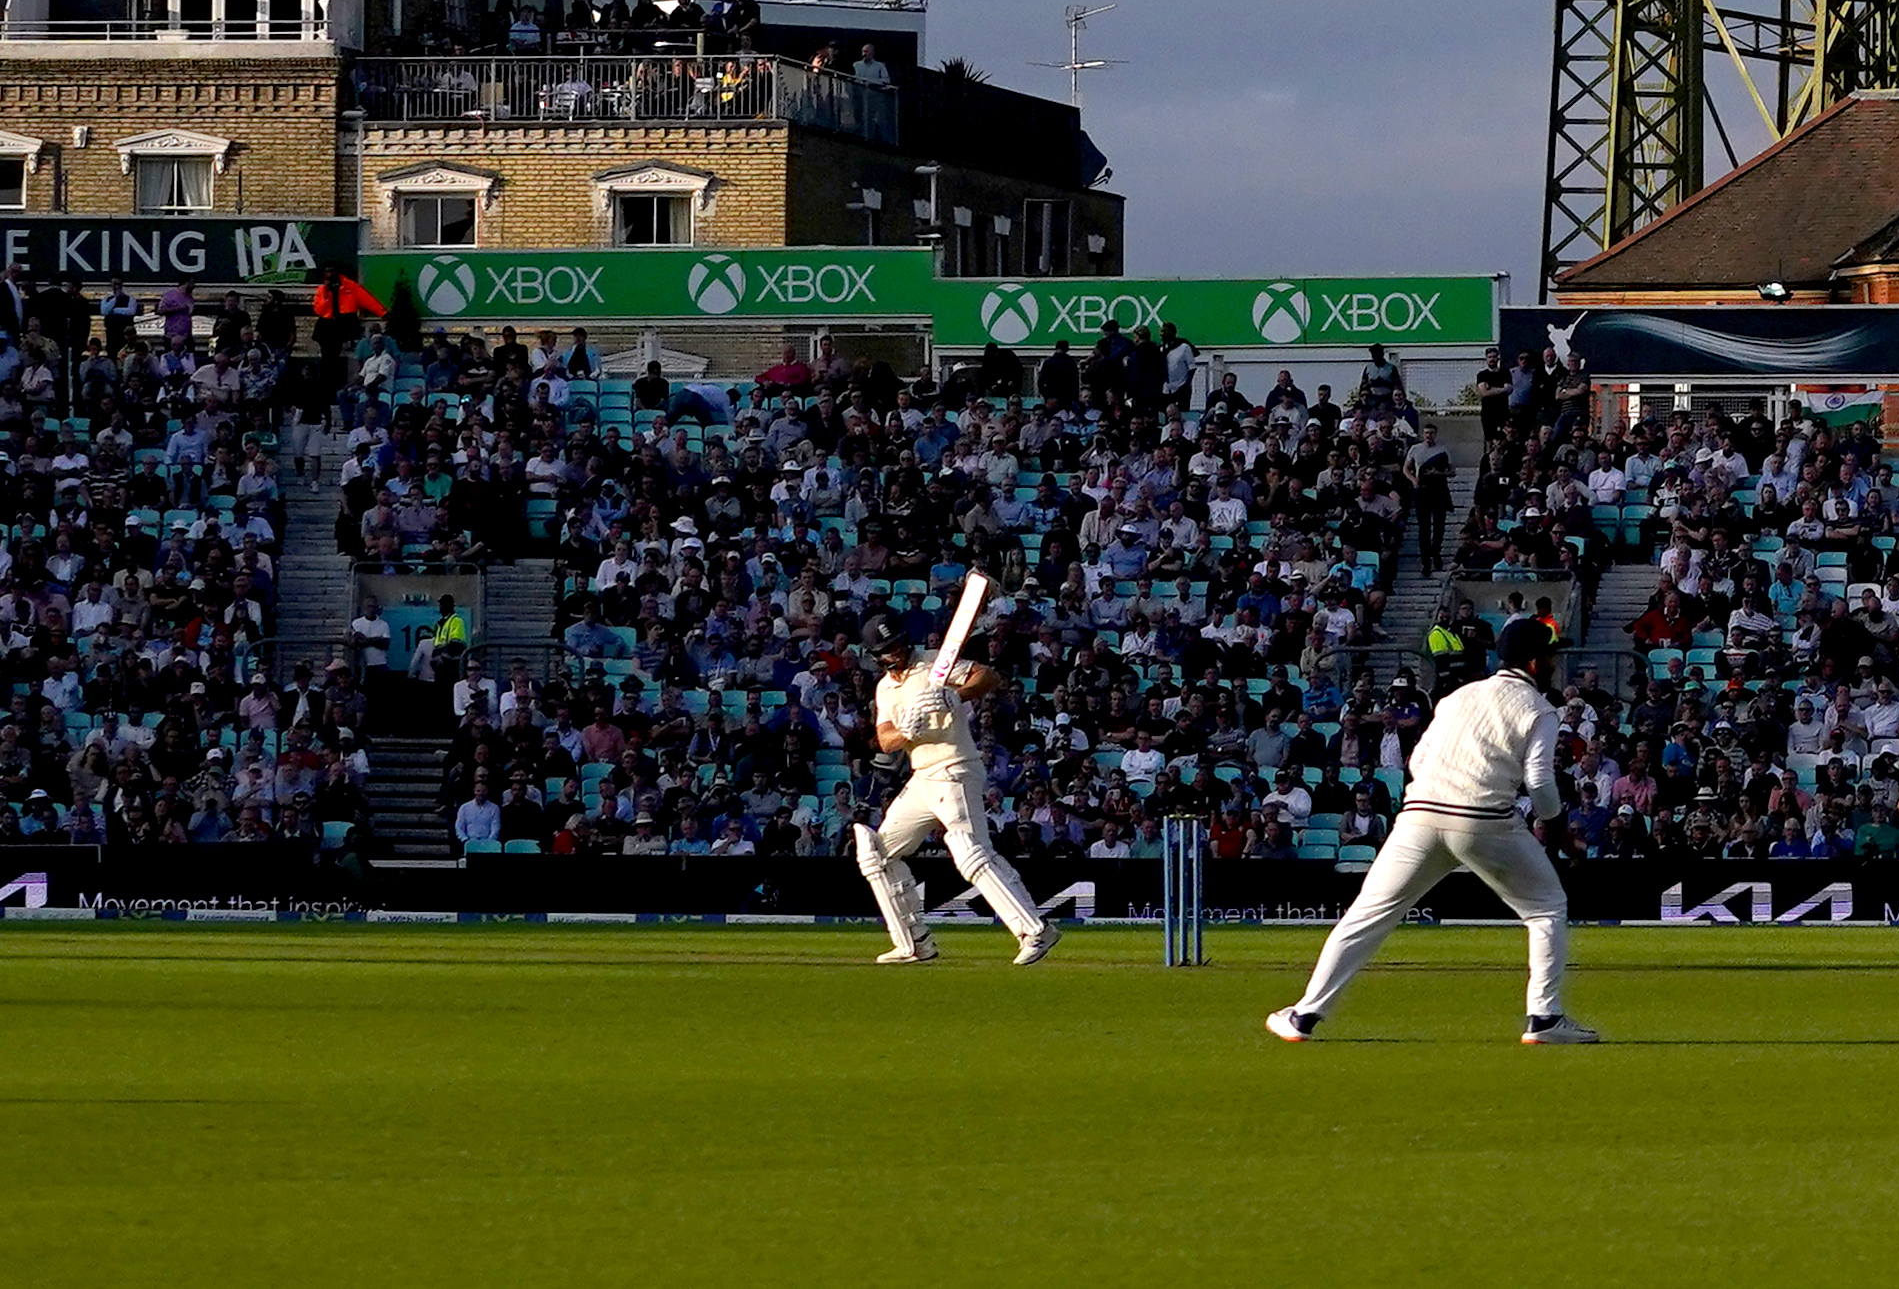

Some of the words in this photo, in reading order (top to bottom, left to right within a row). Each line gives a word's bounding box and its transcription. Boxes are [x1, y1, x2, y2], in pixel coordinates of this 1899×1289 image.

[59, 229, 206, 273] KING
[235, 222, 317, 278] IPA
[486, 266, 605, 305] XBOX
[756, 264, 877, 303] XBOX
[1048, 294, 1169, 334] XBOX
[1321, 292, 1442, 332] XBOX
[227, 894, 281, 911] that
[1275, 902, 1327, 921] that
[1660, 881, 1853, 922] KIA
